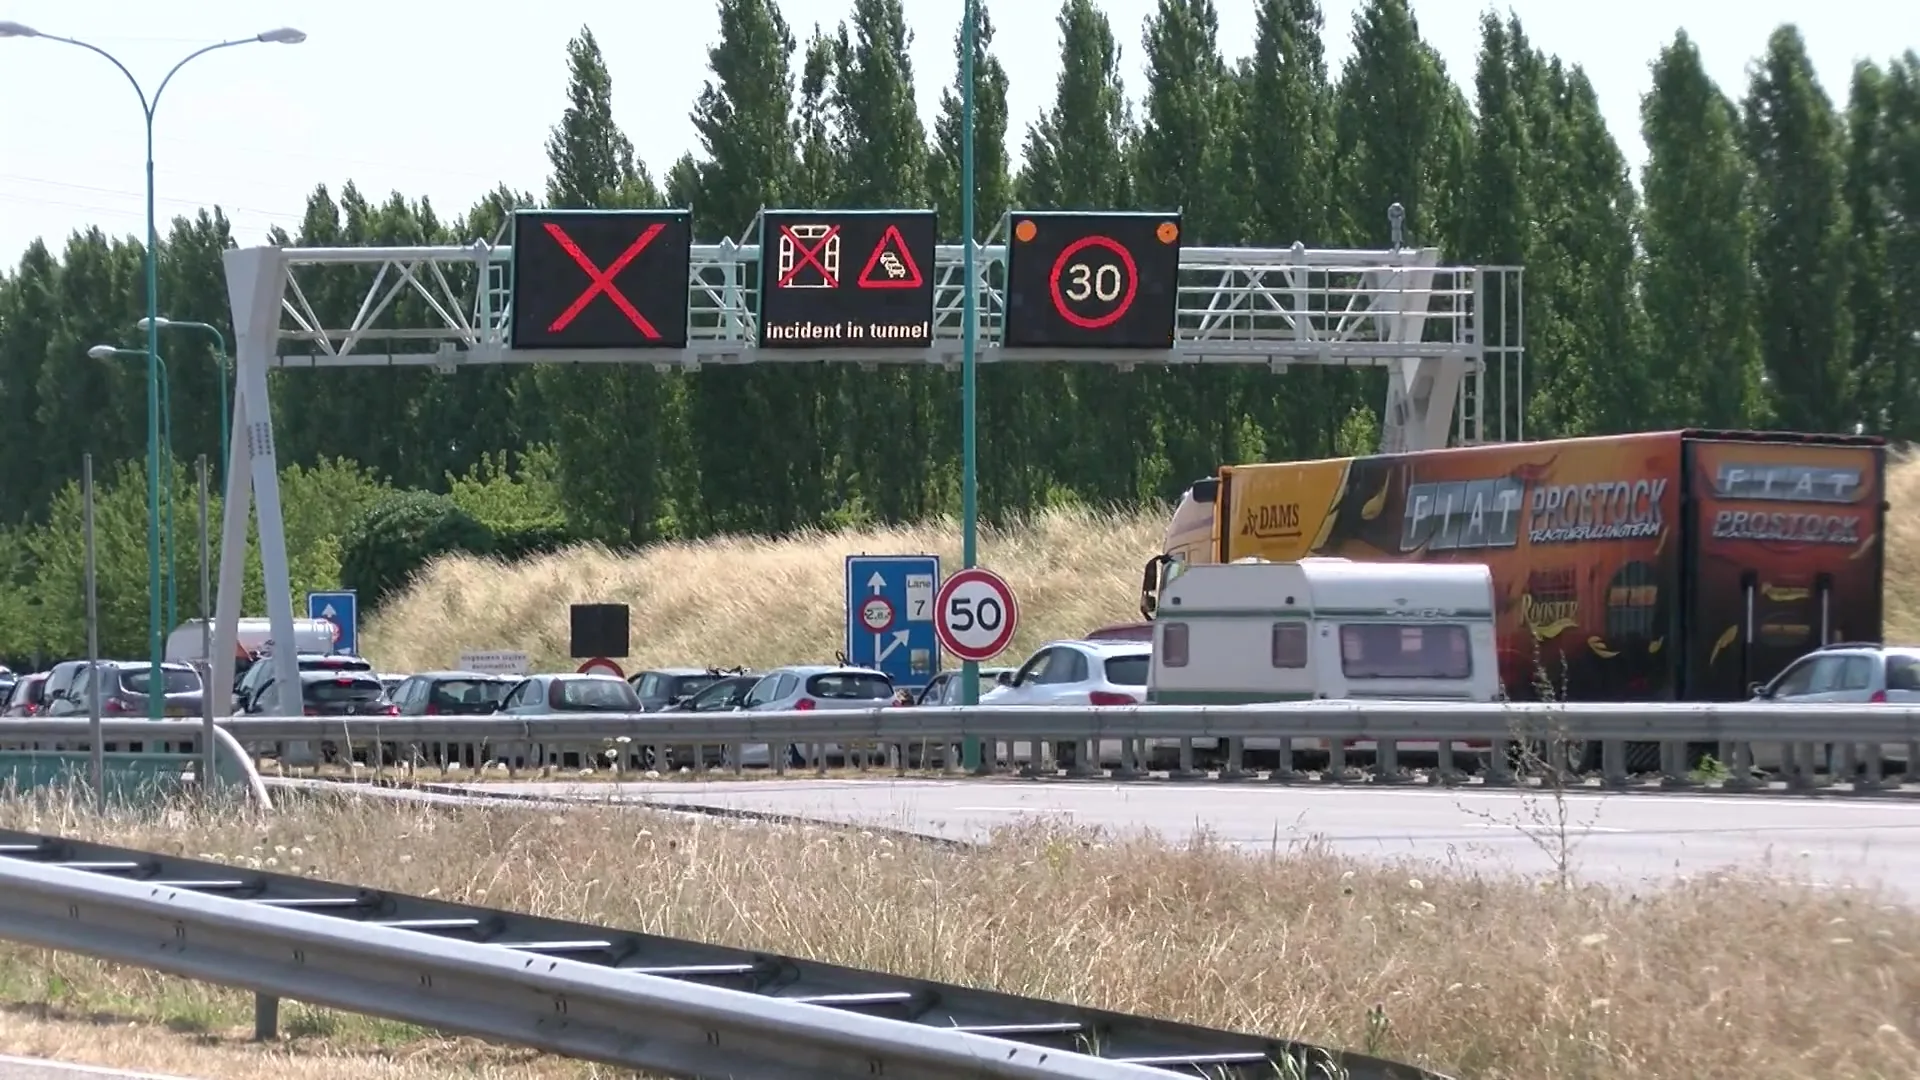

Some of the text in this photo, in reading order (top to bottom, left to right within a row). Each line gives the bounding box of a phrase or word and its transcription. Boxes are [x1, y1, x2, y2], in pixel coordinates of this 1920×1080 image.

[1066, 263, 1121, 301] 30
[766, 321, 928, 339] incident in tunnel
[1726, 469, 1850, 496] FIAT
[1260, 503, 1300, 529] DAMS
[1411, 489, 1518, 539] FIAT
[1529, 479, 1667, 532] PROSTOCK
[1713, 510, 1860, 537] PROSTOCK
[907, 579, 931, 588] Lane
[914, 600, 925, 616] 7
[951, 597, 1001, 631] 50
